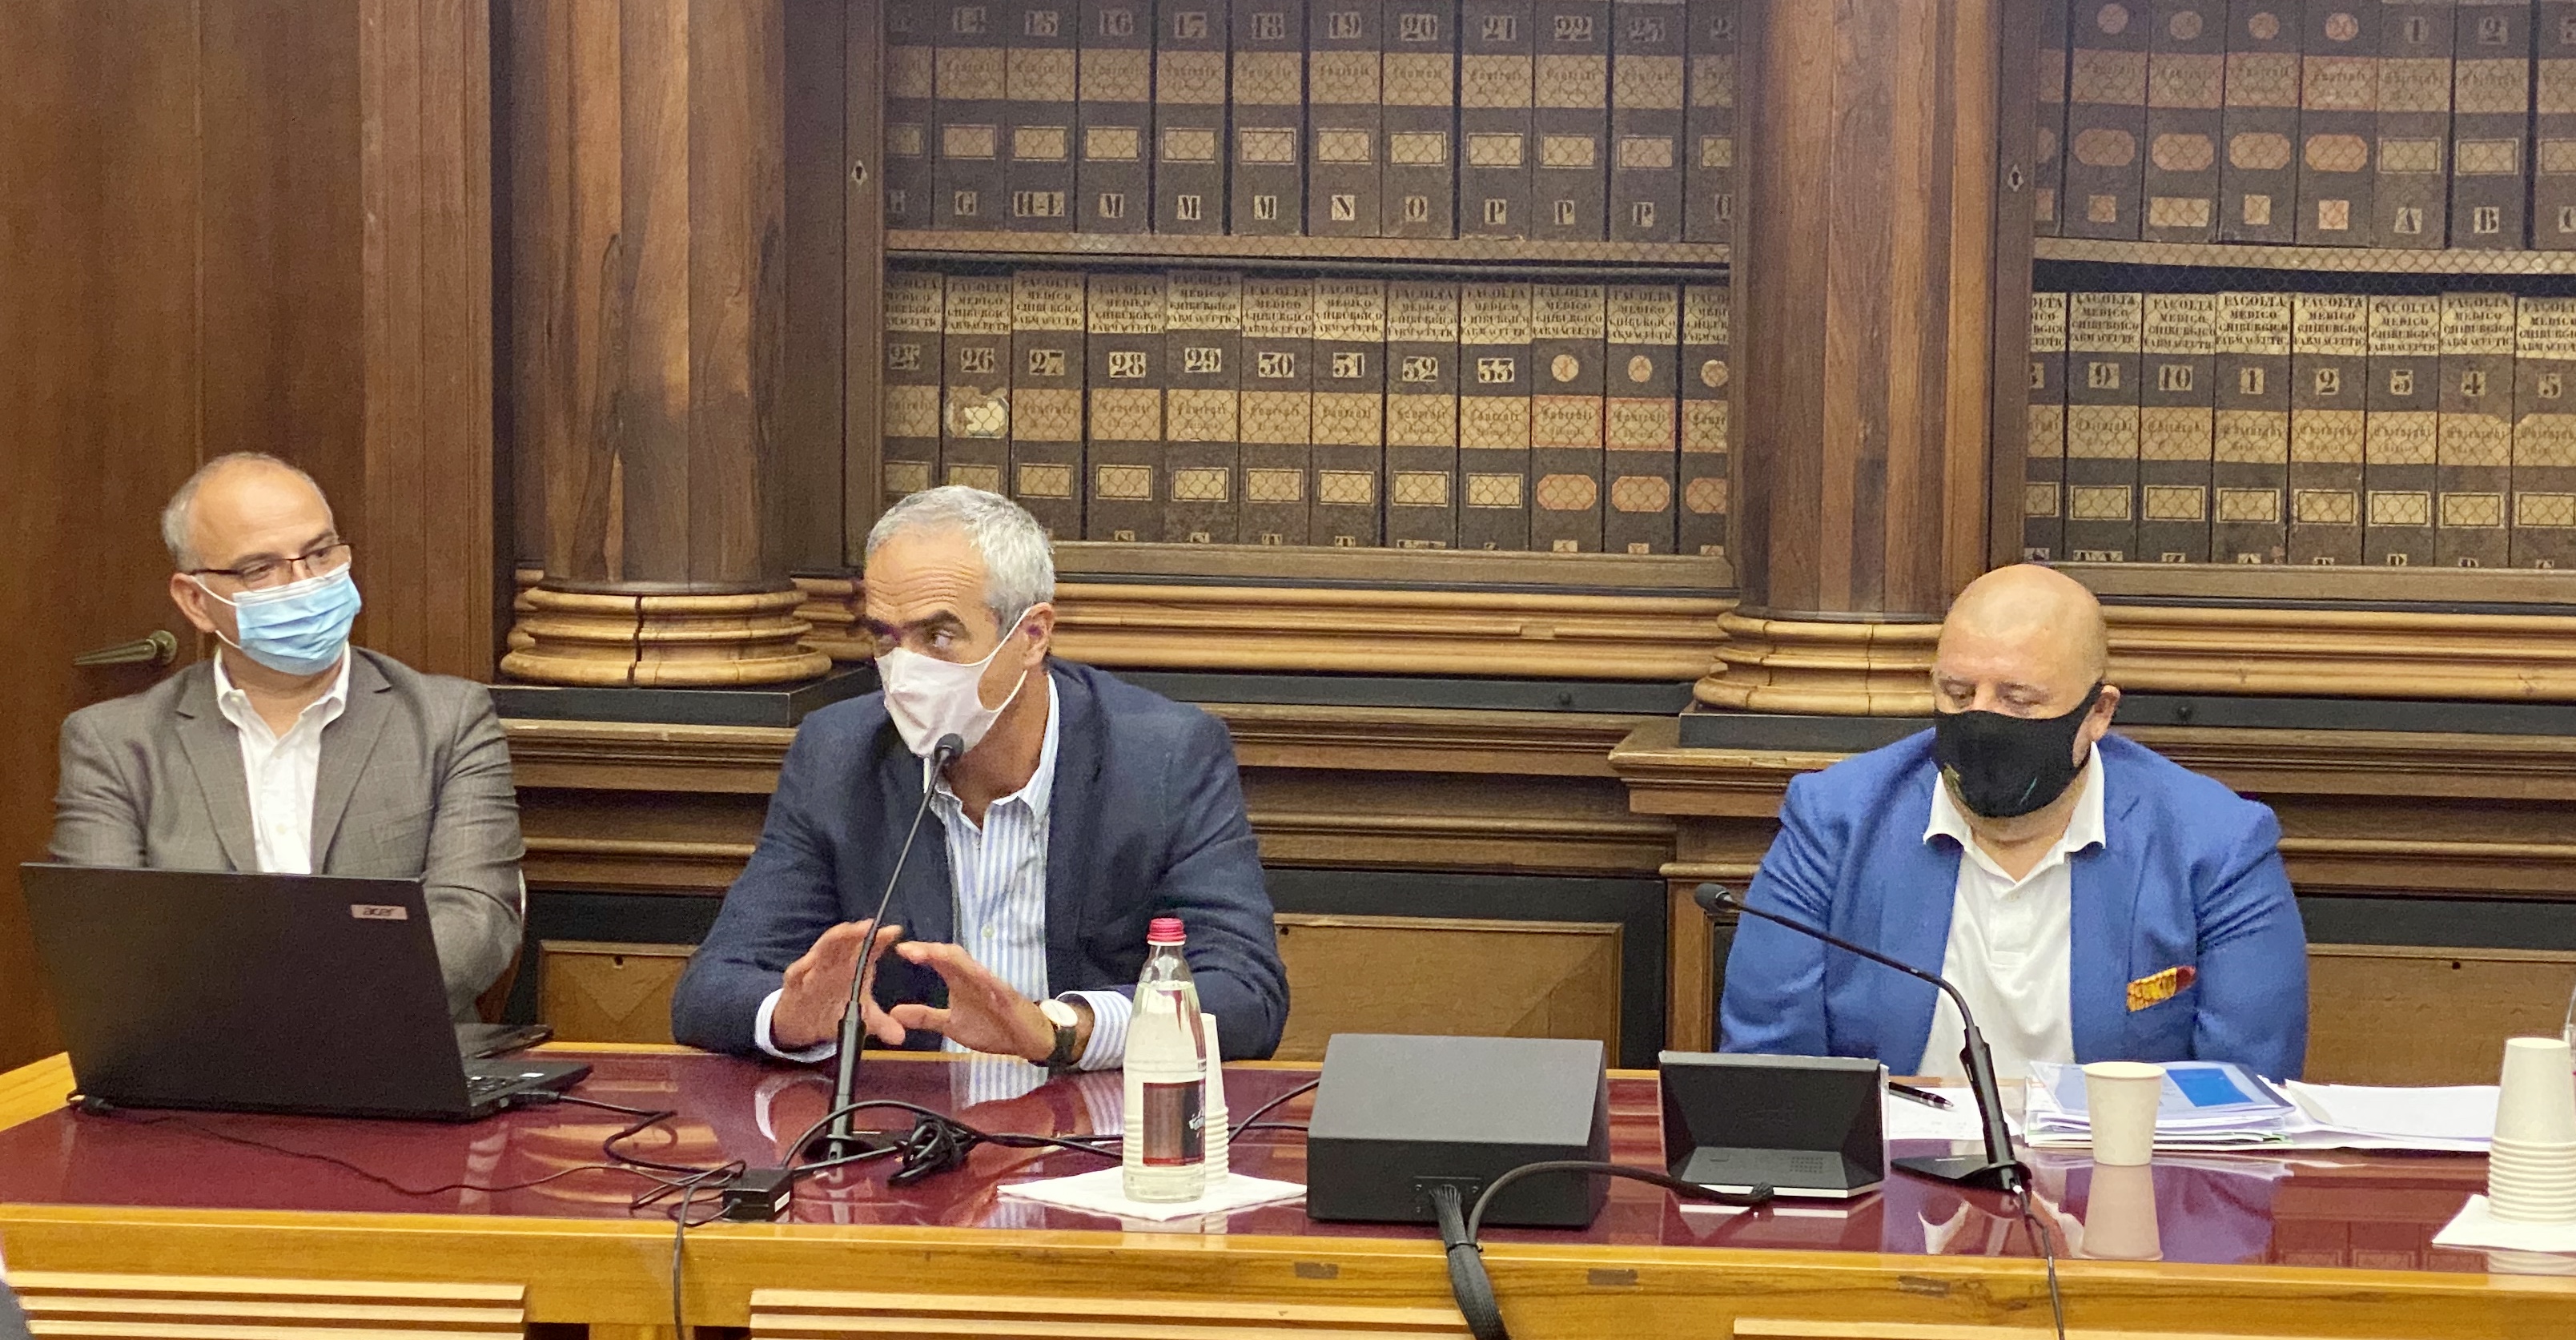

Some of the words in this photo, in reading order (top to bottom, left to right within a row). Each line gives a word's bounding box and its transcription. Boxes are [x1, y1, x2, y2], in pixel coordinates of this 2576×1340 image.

[1028, 12, 1055, 34] 15
[1102, 12, 1132, 34] 16
[1332, 14, 1360, 36] 19
[1404, 16, 1436, 38] 20
[1484, 17, 1513, 38] 21
[1557, 17, 1589, 38] 22
[2484, 19, 2502, 42] 2
[1102, 195, 1121, 217] M
[1179, 197, 1199, 219] M
[1256, 197, 1275, 218] M
[1332, 196, 1353, 218] N
[1489, 201, 1505, 223] P
[1557, 201, 1573, 223] P
[1636, 203, 1652, 225] P
[2397, 208, 2417, 232] A
[2481, 208, 2498, 231] B
[2083, 308, 2128, 316] MEDICO
[2160, 313, 2206, 323] MEDICO
[2230, 310, 2277, 320] MEDICO
[2309, 312, 2356, 320] MEDICO
[2382, 317, 2429, 326] MEDICO
[2454, 311, 2502, 321] MEDICO
[962, 348, 994, 371] 26
[1031, 351, 1063, 374] 27
[1111, 353, 1144, 376] 28
[1186, 348, 1220, 372] 29
[1260, 354, 1293, 376] 30
[1334, 355, 1362, 376] 31
[1404, 357, 1437, 380] 32
[1479, 360, 1513, 381] 33
[2094, 364, 2112, 386] 9
[2163, 367, 2192, 389] 10
[2248, 369, 2257, 392] 1
[2319, 371, 2336, 393] 2
[2463, 372, 2482, 395] 4
[2542, 374, 2558, 396] 5
[363, 907, 397, 915] acer
